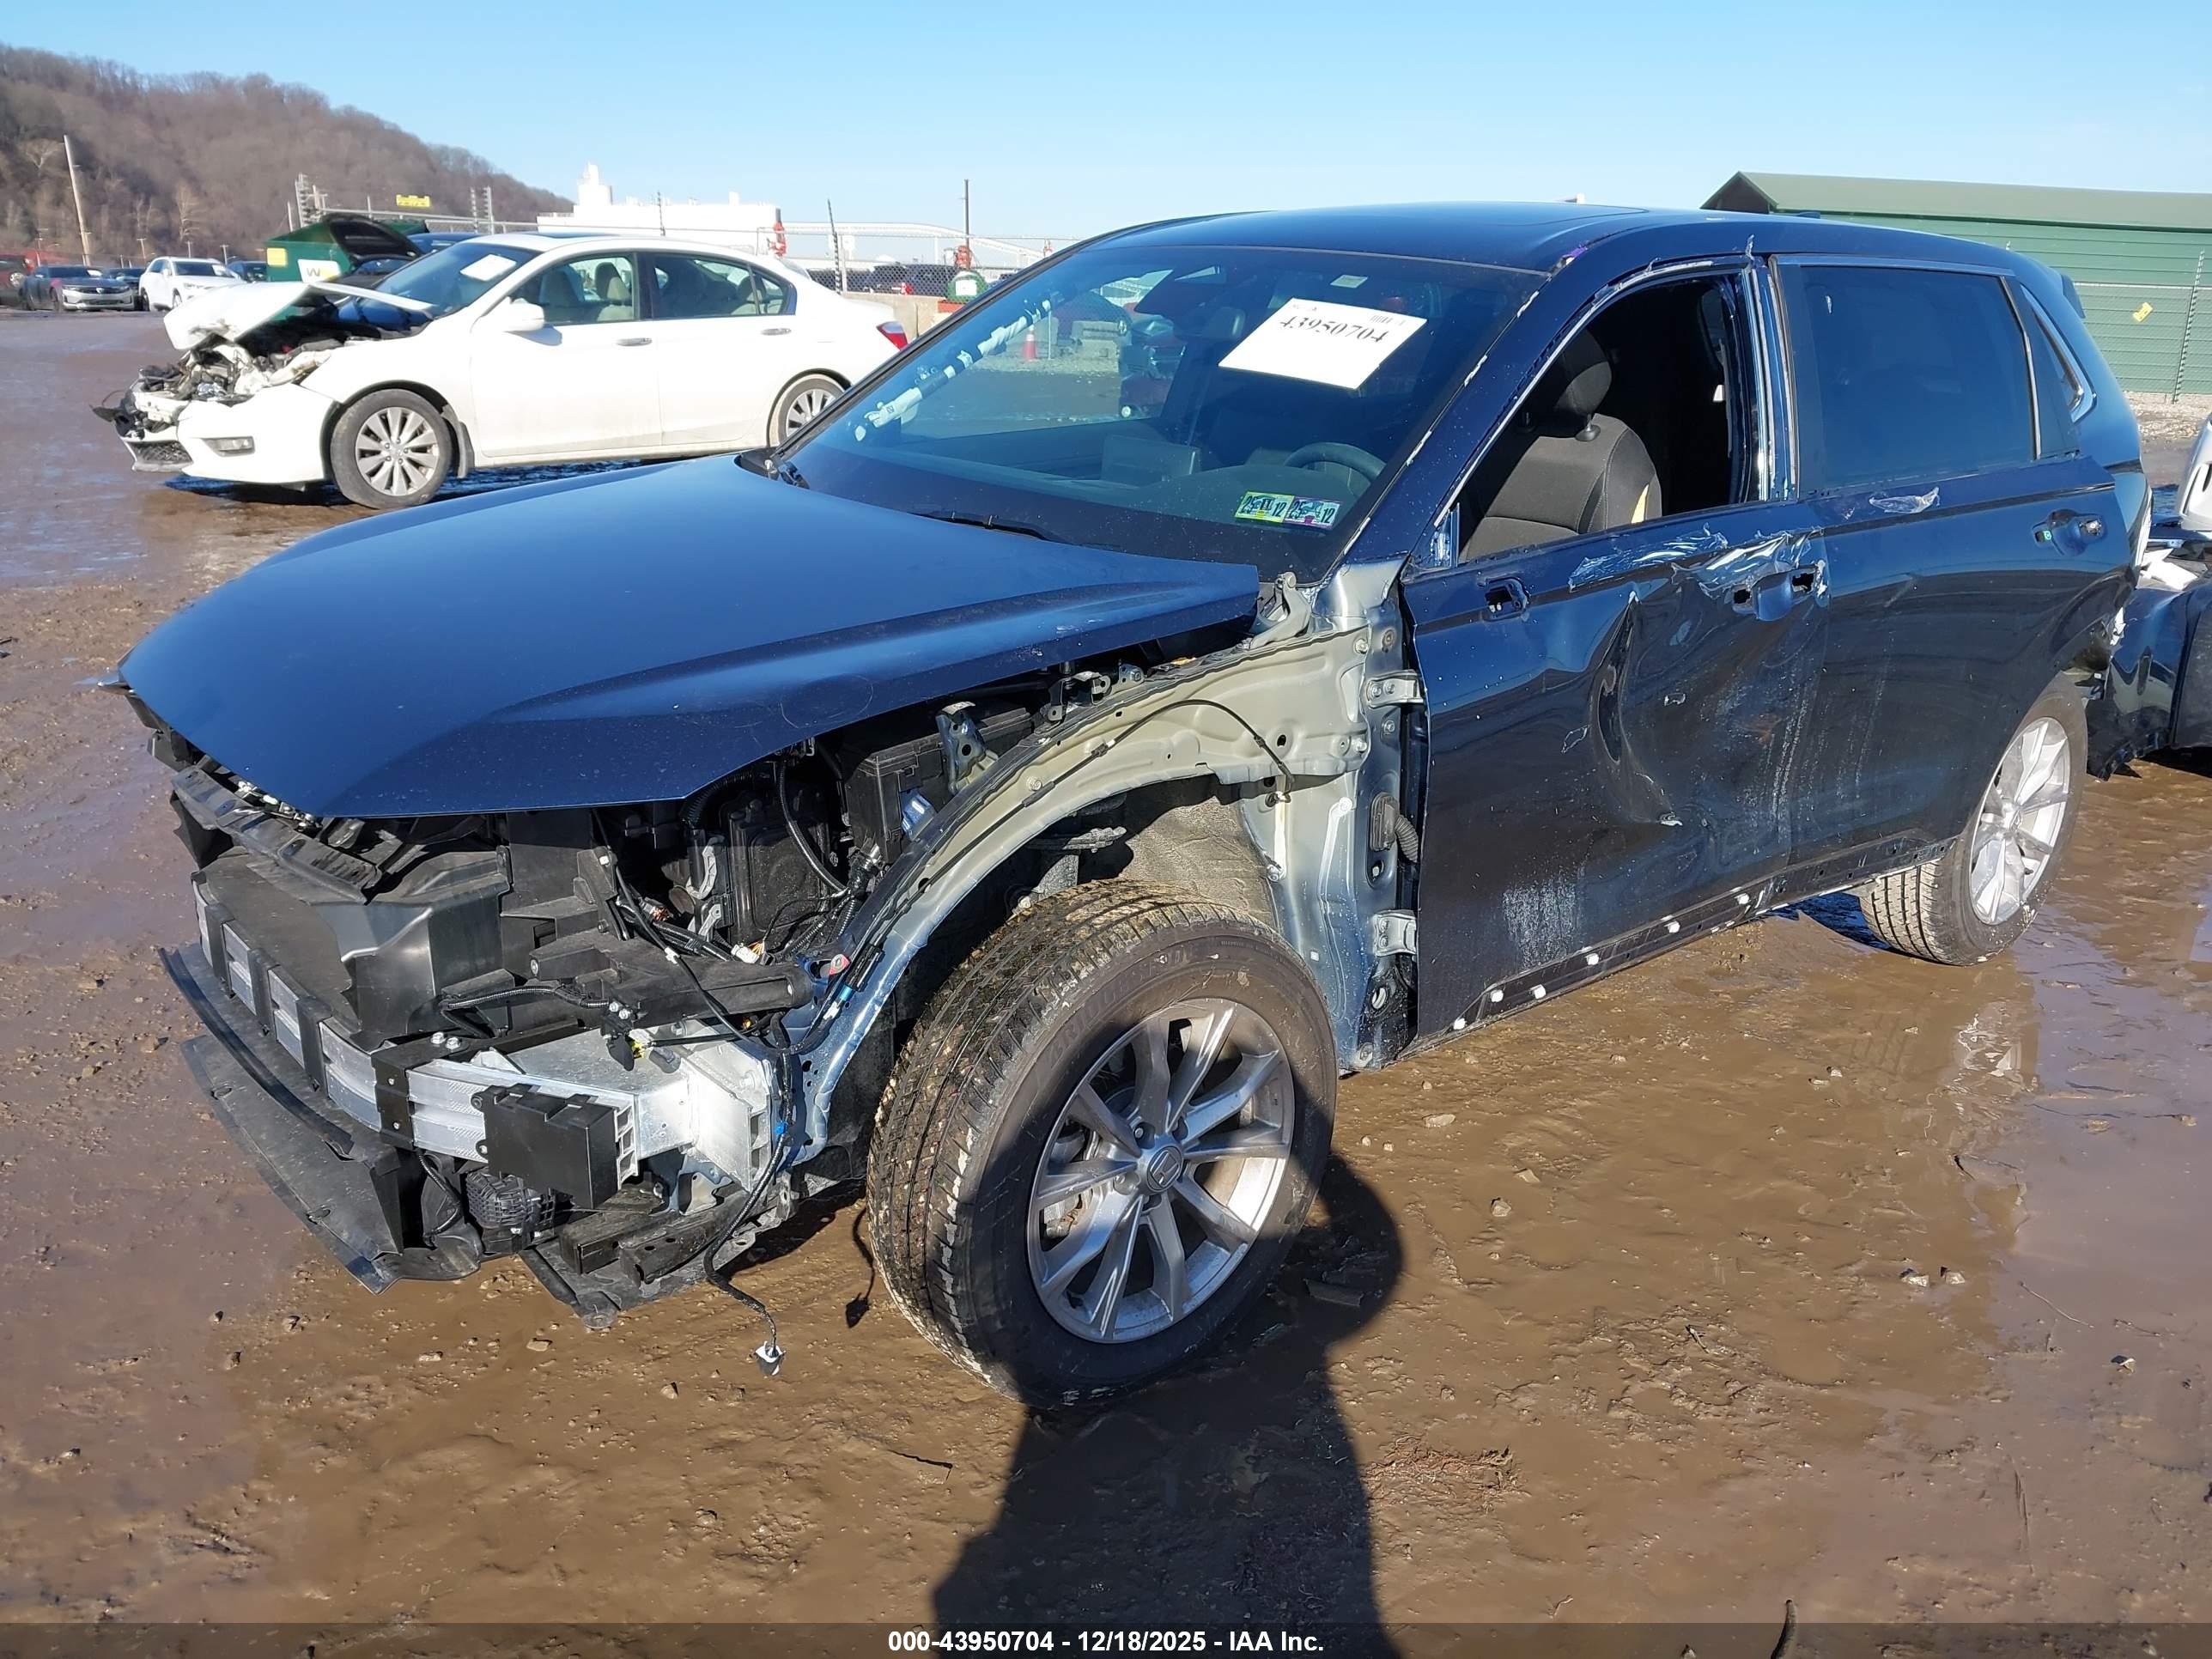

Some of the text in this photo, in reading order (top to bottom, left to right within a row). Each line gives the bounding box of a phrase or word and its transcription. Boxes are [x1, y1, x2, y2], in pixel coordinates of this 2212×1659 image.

[1279, 315, 1389, 343] 43950704
[1271, 501, 1287, 518] 12
[1320, 507, 1335, 524] 12
